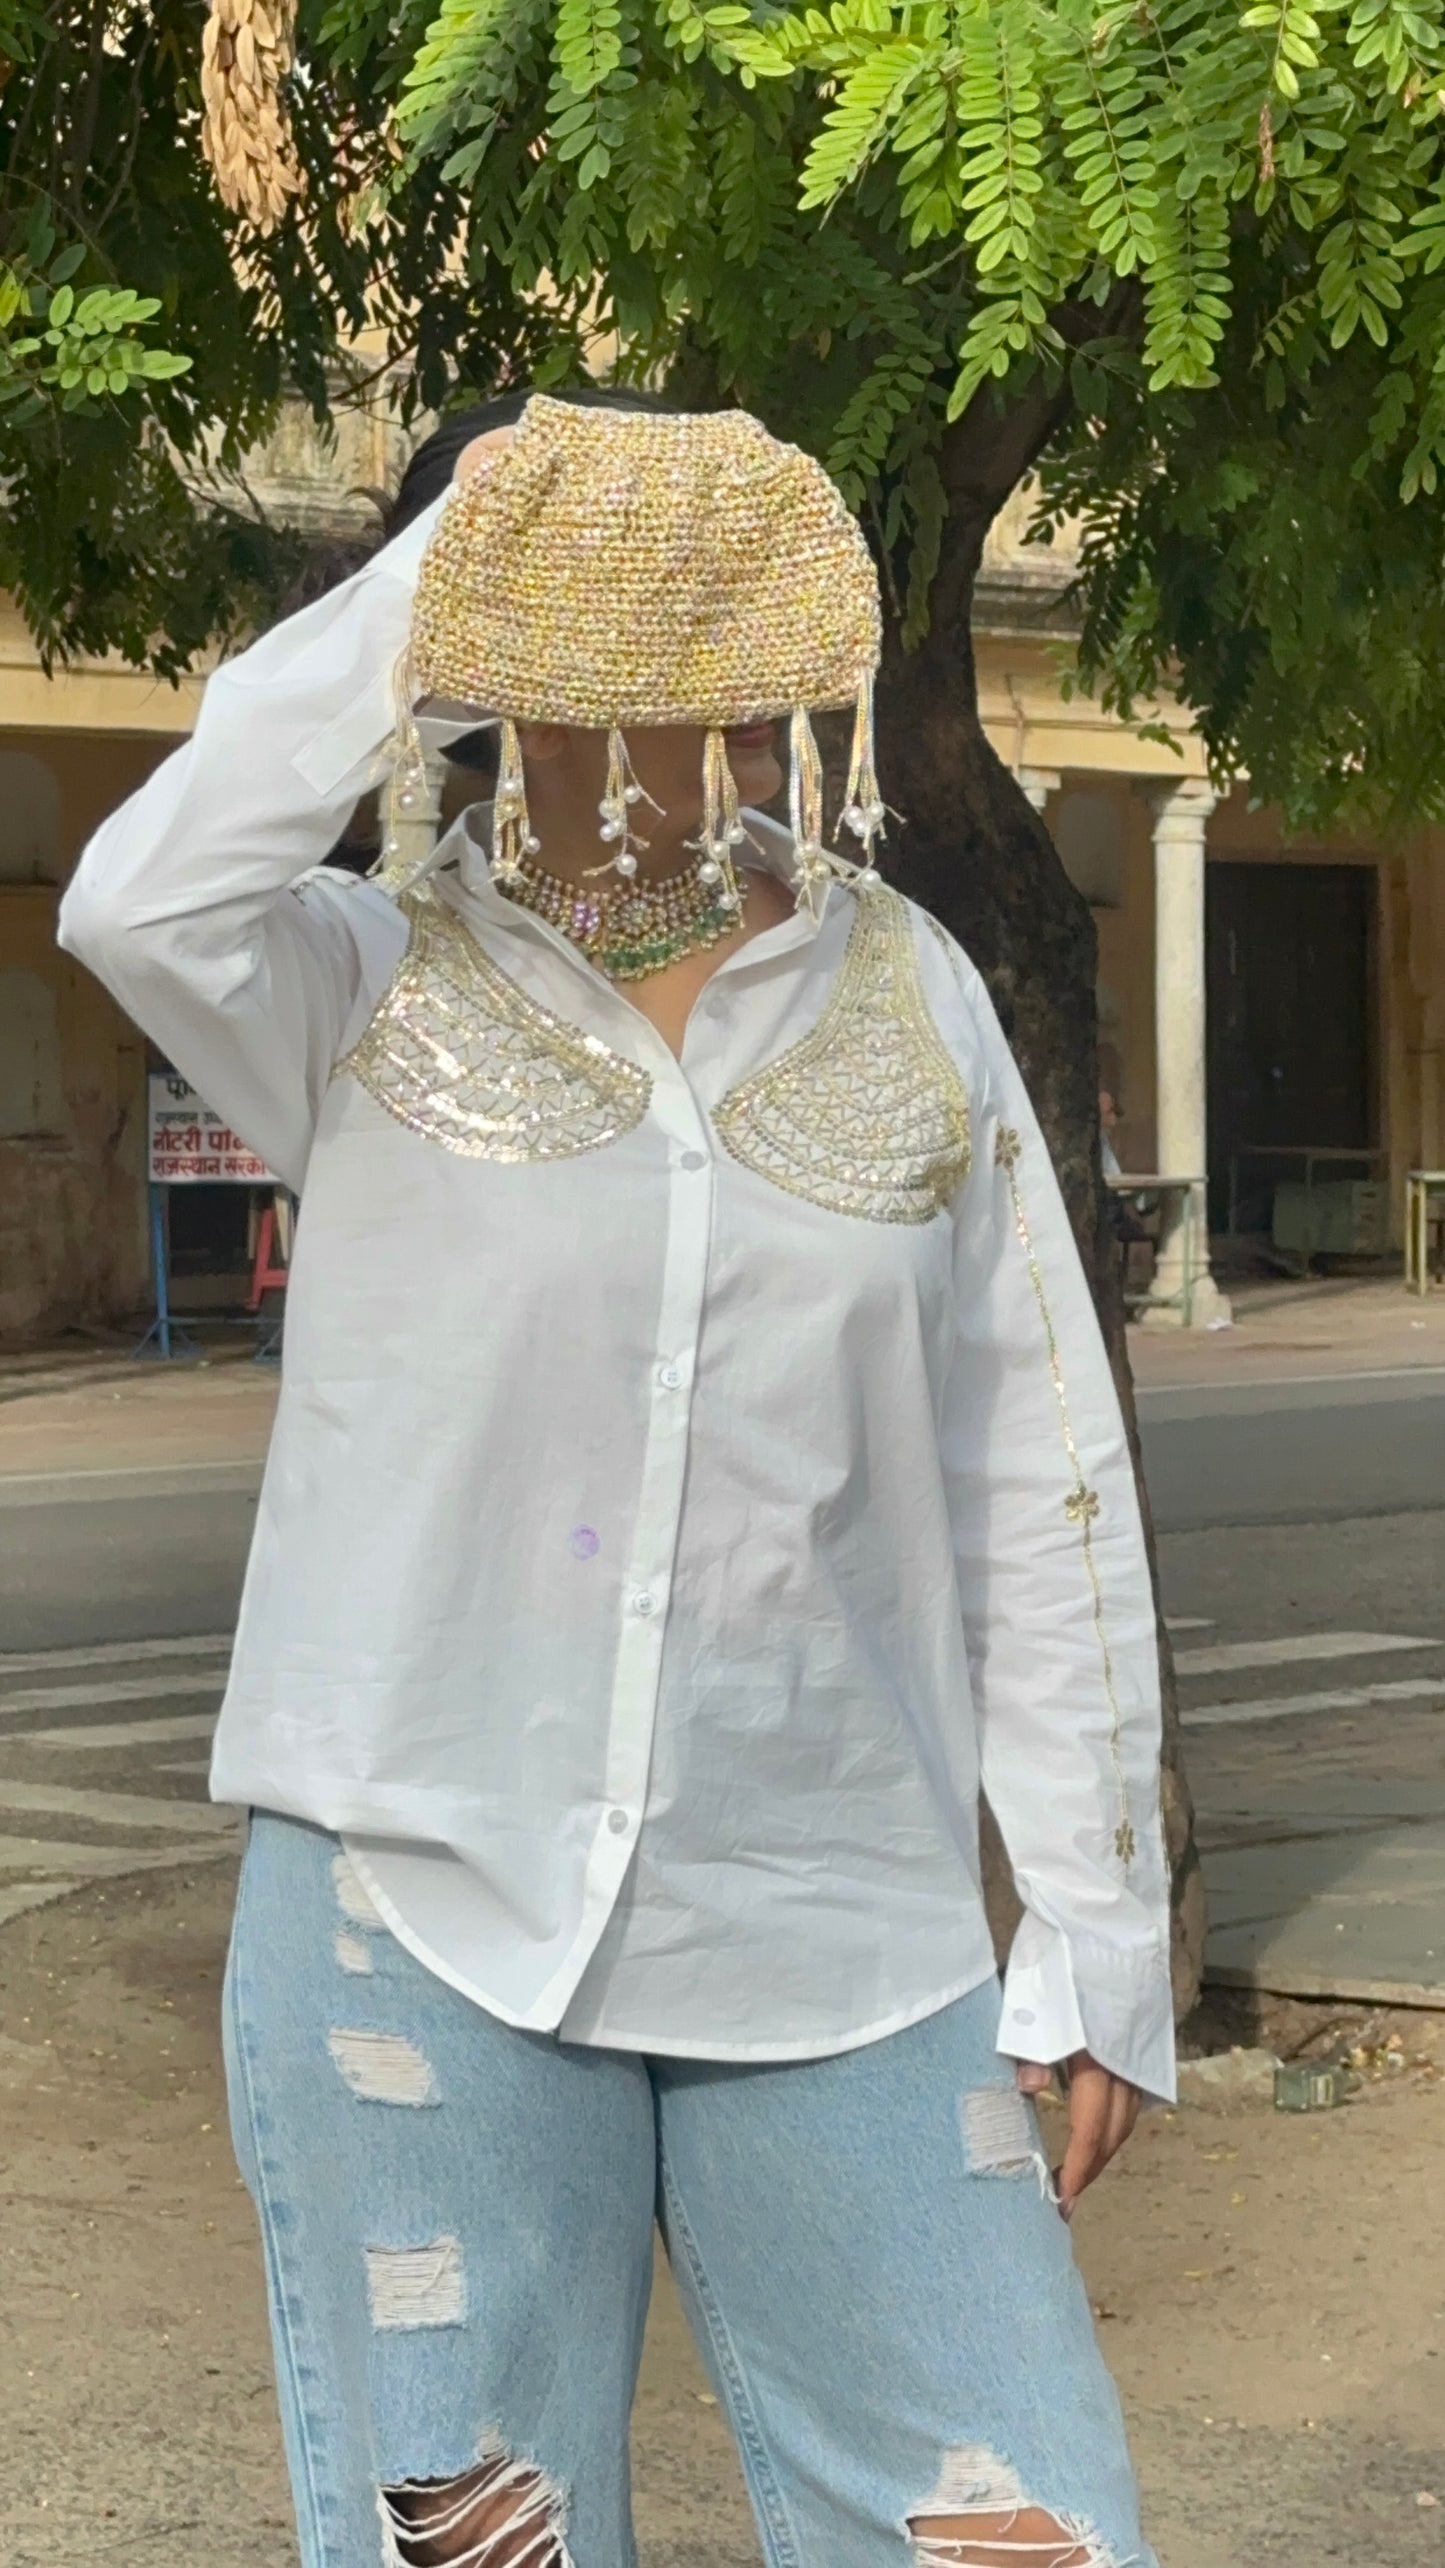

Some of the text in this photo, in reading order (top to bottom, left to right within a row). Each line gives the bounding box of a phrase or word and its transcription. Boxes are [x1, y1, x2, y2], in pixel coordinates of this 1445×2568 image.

[152, 1125, 202, 1152] नोटरी
[152, 1156, 267, 1177] राजस्थान सरका
